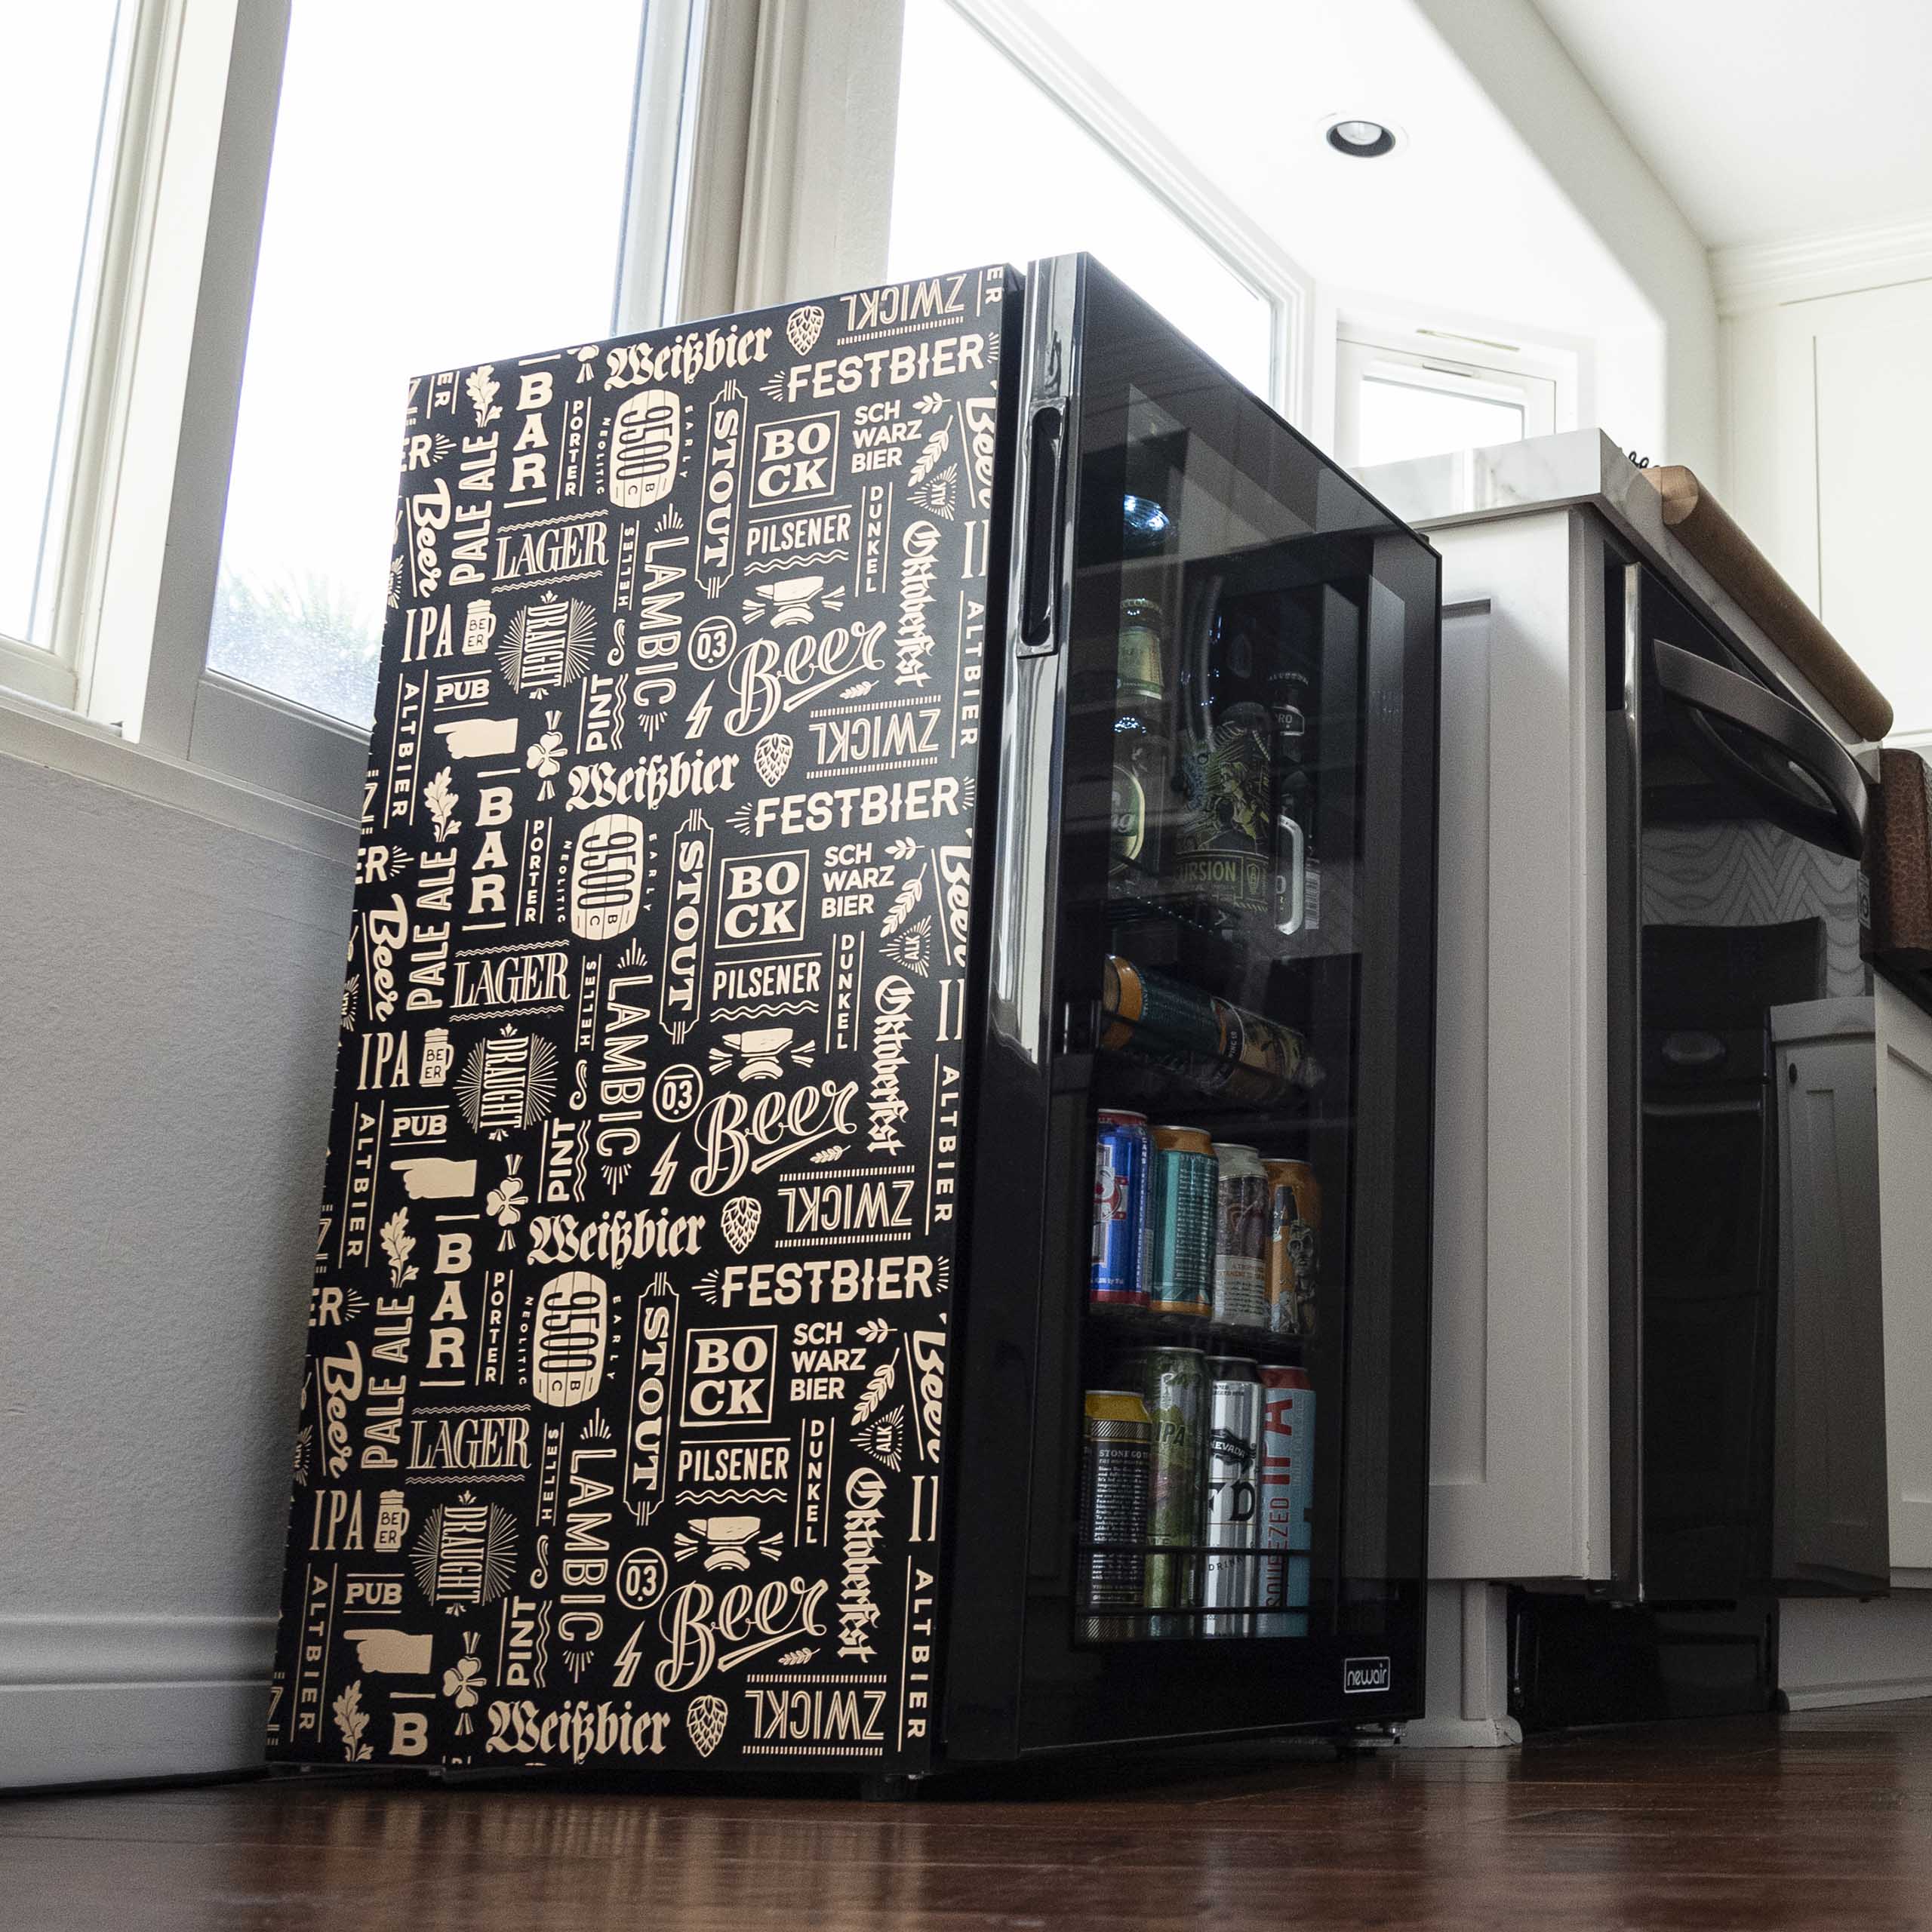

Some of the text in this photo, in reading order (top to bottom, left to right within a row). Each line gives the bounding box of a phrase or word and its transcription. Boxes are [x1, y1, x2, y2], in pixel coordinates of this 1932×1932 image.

[840, 273, 967, 334] ZWICKL
[605, 325, 772, 391] Weißbier
[787, 331, 984, 402] FESTBIER
[509, 372, 552, 492] BAR
[565, 401, 583, 496] PORTER
[616, 405, 673, 480] 9500
[680, 405, 694, 477] EARLY
[761, 423, 830, 462] BO
[853, 420, 922, 449] WARZ
[854, 400, 900, 425] SCH
[596, 418, 611, 494] NEOLITIC
[704, 409, 738, 567] STOUT
[758, 457, 828, 497] CK
[851, 448, 902, 473] BIER
[931, 482, 946, 505] ALK
[413, 478, 451, 598] Beer
[449, 431, 498, 586] PALE ALE
[747, 513, 851, 555] PILSENER
[866, 486, 883, 592] DUNKEL
[492, 521, 609, 580] LAGER
[618, 528, 635, 606] HELLES
[401, 604, 453, 663] IPA
[468, 635, 485, 648] ER
[469, 619, 487, 631] BE
[634, 537, 689, 706] LAMBIC
[894, 521, 941, 687] Oktoberfest
[521, 601, 568, 688] DRAUGHT
[724, 621, 888, 736] Beer
[960, 601, 984, 746] ALTBIER
[435, 679, 489, 703] PUB
[586, 674, 613, 752] PINT
[392, 683, 420, 817] ALTBIER
[809, 709, 940, 764] ZWICKL
[566, 749, 740, 811] Weißbier
[755, 777, 958, 837] FESTBIER
[469, 786, 512, 913] BAR
[525, 820, 544, 921] PORTER
[557, 841, 572, 922] NEOLITIC
[577, 832, 636, 907] 9500
[644, 833, 657, 910] EARLY
[728, 861, 799, 900] BO
[823, 866, 895, 892] WARZ
[824, 842, 872, 866] SCH
[406, 848, 457, 1011] PALE ALE
[669, 841, 704, 1011] STOUT
[724, 900, 797, 938] CK
[822, 894, 874, 918] BIER
[370, 894, 408, 1022] Beer
[450, 952, 571, 1008] LAGER
[713, 961, 820, 1000] PILSENER
[905, 936, 920, 960] ALK
[580, 960, 597, 1045] HELLES
[838, 934, 854, 1048] DUNKEL
[357, 1030, 410, 1090] IPA
[426, 1049, 444, 1061] BE
[426, 1067, 441, 1078] ER
[480, 1037, 528, 1128] DRAUGHT
[597, 975, 653, 1156] LAMBIC
[866, 975, 915, 1155] Oktoberfest
[392, 1115, 447, 1137] PUB
[547, 1118, 575, 1201] PINT
[691, 1080, 860, 1196] Beer
[935, 1066, 959, 1221] ALTBIER
[347, 1113, 375, 1256] ALTBIER
[778, 1180, 914, 1232] ZWICKL
[528, 1208, 706, 1269] Weißbier
[426, 1233, 472, 1368] BAR
[721, 1256, 933, 1307] FESTBIER
[485, 1272, 504, 1382] PORTER
[518, 1297, 534, 1385] NEOLITIC
[539, 1291, 600, 1373] 9500
[607, 1296, 621, 1379] EARLY
[693, 1337, 768, 1374] BO
[792, 1349, 866, 1373] WARZ
[793, 1321, 842, 1345] SCH
[323, 1341, 362, 1478] Beer
[361, 1296, 414, 1468] PALE ALE
[633, 1306, 669, 1490] STOUT
[691, 1379, 764, 1415] CK
[791, 1377, 844, 1401] BIER
[407, 1417, 531, 1469] LAGER
[542, 1429, 558, 1519] HELLES
[678, 1447, 789, 1481] PILSENER
[876, 1426, 892, 1452] ALK
[382, 1512, 398, 1525] BE
[807, 1420, 824, 1543] DUNKEL
[309, 1490, 364, 1550] IPA
[380, 1531, 396, 1543] ER
[435, 1505, 488, 1606] DRAUGHT
[558, 1449, 617, 1641] LAMBIC
[345, 1583, 401, 1604] PUB
[837, 1468, 887, 1663] Oktoberfest
[299, 1576, 328, 1729] ALTBIER
[507, 1596, 536, 1685] PINT
[655, 1577, 829, 1692] Beer
[908, 1569, 933, 1737] ALTBIER
[1347, 1663, 1387, 1686] newair
[486, 1700, 670, 1764] Weißbier
[745, 1690, 886, 1740] ZWICKL
